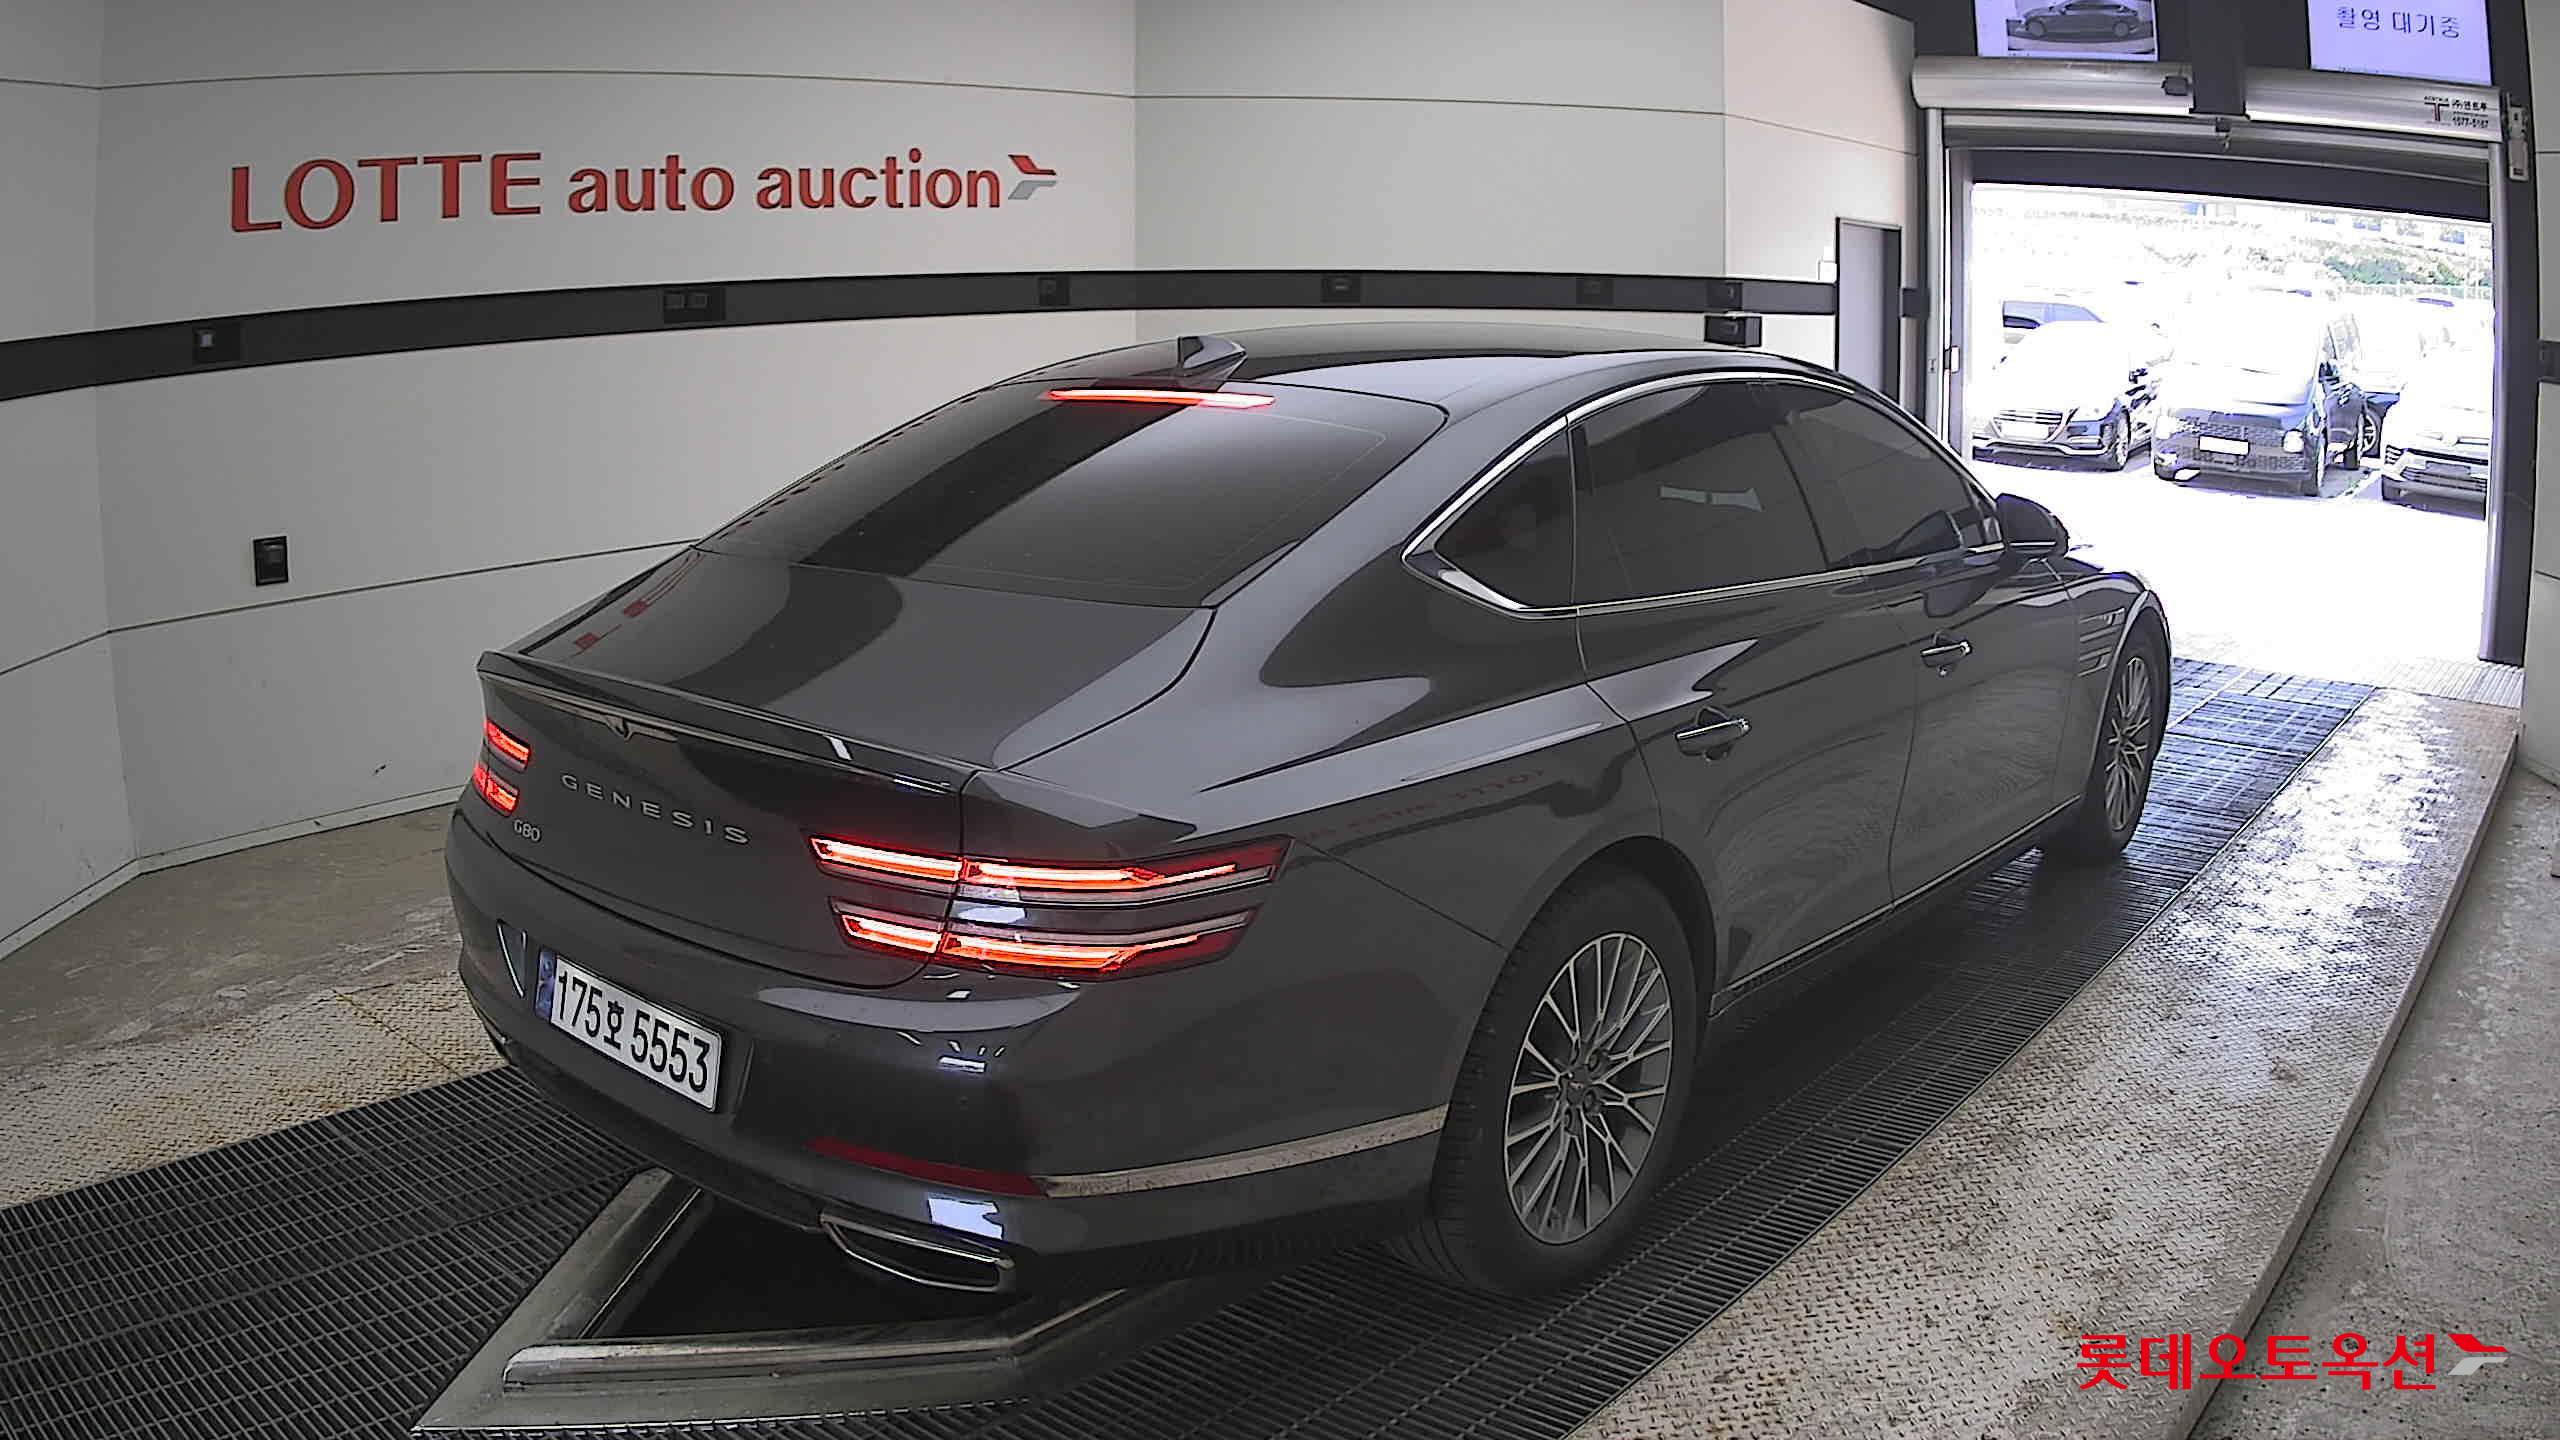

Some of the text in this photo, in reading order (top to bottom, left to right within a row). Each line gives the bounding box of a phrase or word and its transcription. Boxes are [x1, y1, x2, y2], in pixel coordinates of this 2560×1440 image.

[2337, 6, 2461, 39] 촬영 대기중
[231, 147, 1002, 232] LOTTE auto auction
[513, 818, 542, 842] G80
[561, 773, 749, 845] GENESIS
[630, 1009, 710, 1092] 5553
